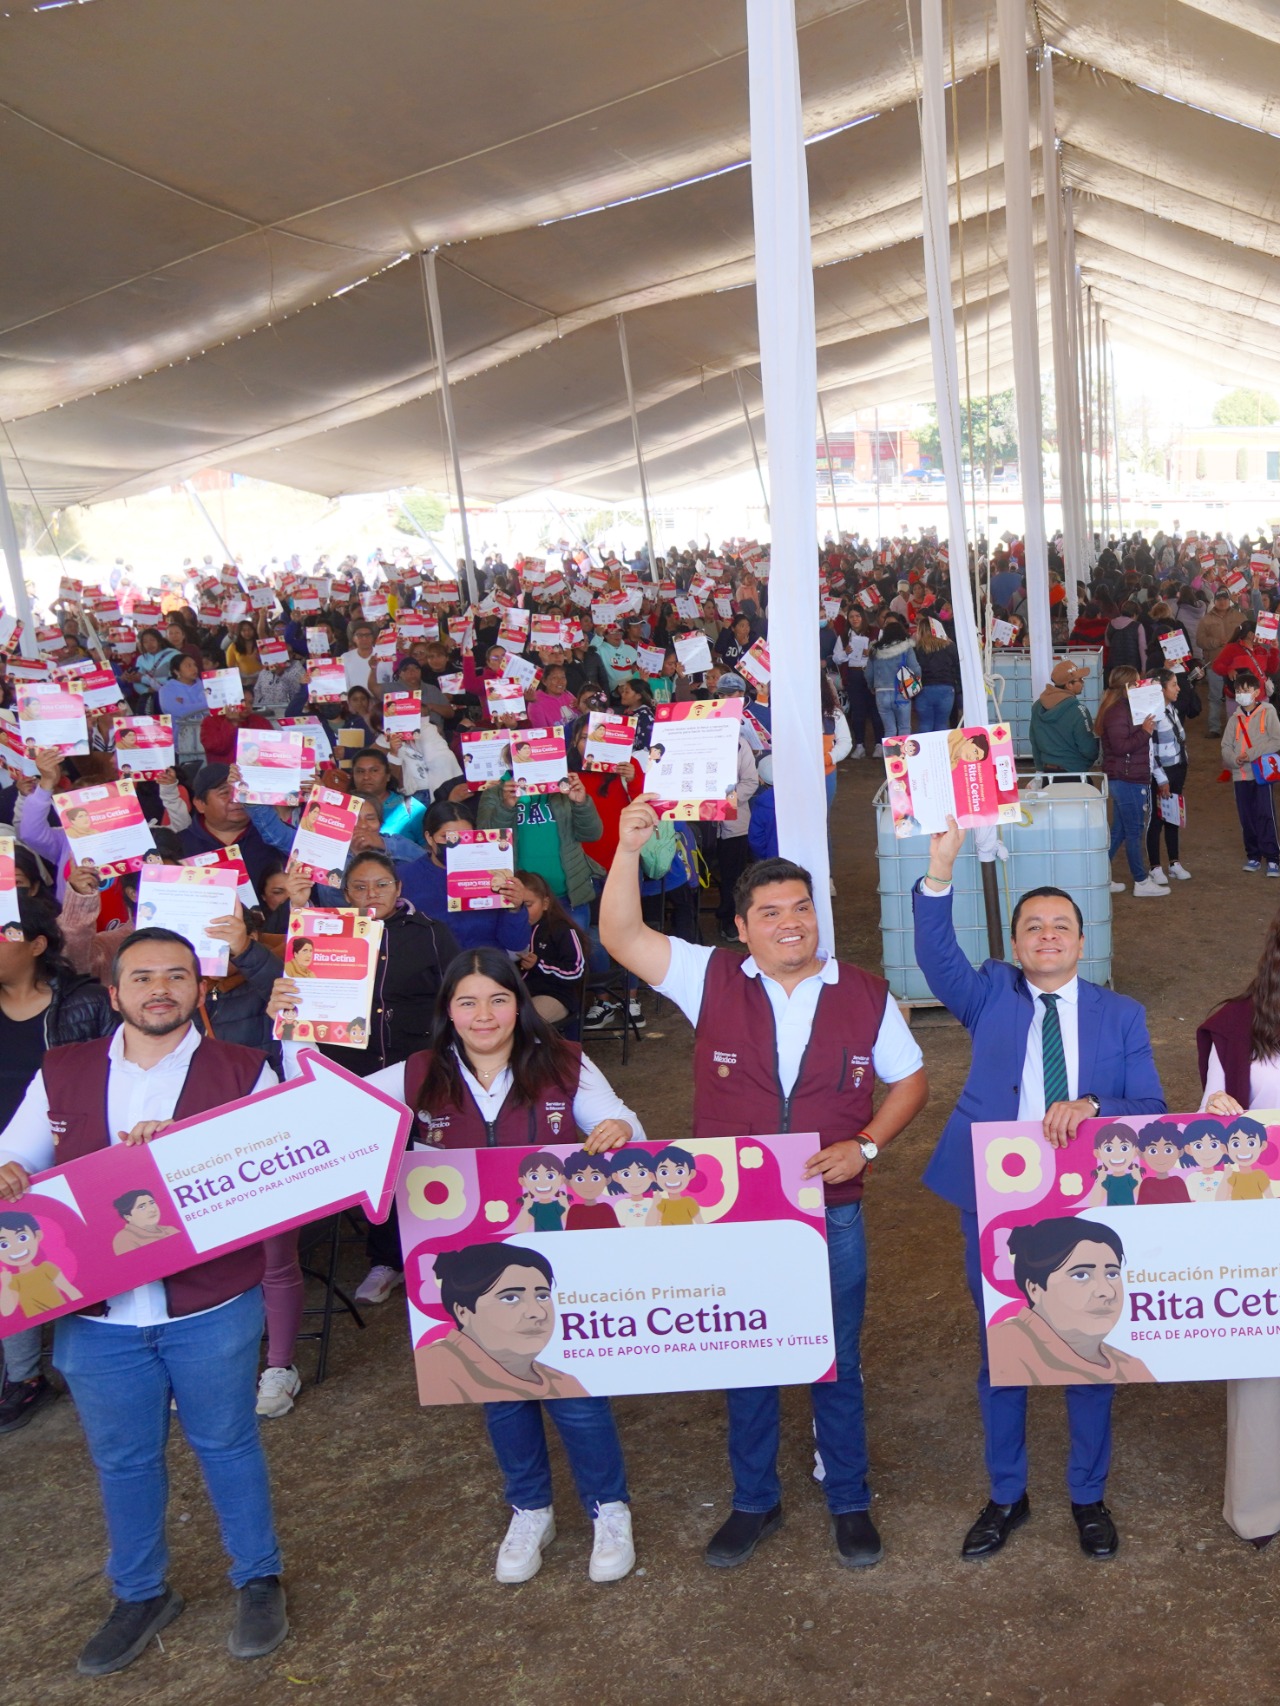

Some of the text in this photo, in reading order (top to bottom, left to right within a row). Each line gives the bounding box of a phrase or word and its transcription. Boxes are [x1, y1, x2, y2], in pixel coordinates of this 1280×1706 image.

[967, 763, 981, 812] Rita Cetina
[313, 953, 356, 963] Rita Cetina
[165, 1129, 292, 1183] Educación Primaria
[173, 1138, 331, 1209] Rita Cetina
[185, 1143, 380, 1222] BECA DE APOYO PARA UNIFORMES Y ÚTILES
[1126, 1266, 1214, 1284] Educación
[557, 1283, 727, 1305] Educación Primaria
[1128, 1289, 1204, 1322] Rita
[560, 1302, 768, 1341] Rita Cetina
[1130, 1330, 1162, 1341] BECA
[1165, 1329, 1181, 1340] DE
[1183, 1327, 1227, 1339] APOYO
[1230, 1326, 1263, 1337] PARA
[563, 1333, 829, 1359] BECA DE APOYO PARA UNIFORMES Y ÚTILES
